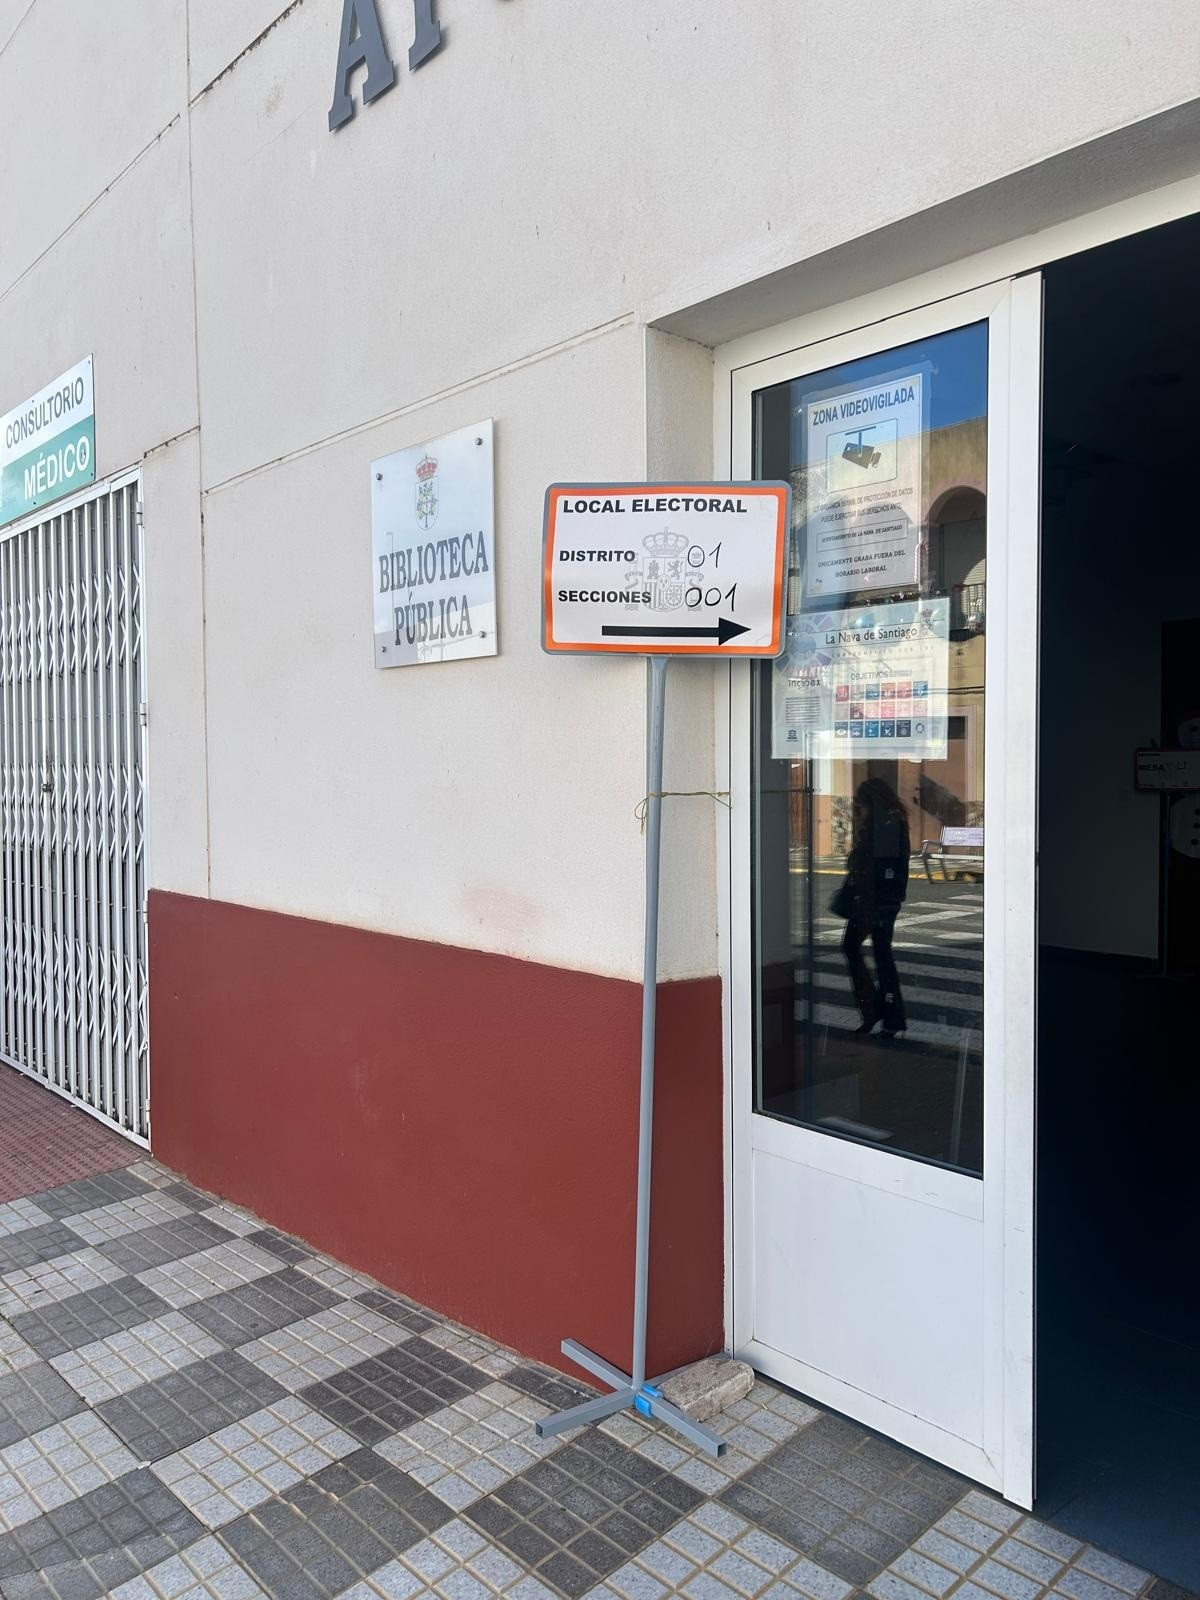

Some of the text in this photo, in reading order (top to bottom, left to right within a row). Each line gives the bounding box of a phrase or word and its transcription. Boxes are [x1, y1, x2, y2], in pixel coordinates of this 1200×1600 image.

[5, 376, 84, 449] CONSULTORIO
[813, 386, 915, 426] ZONA VIDEOVIGILADA
[24, 435, 90, 501] MÉDICO
[562, 498, 748, 513] LOCAL ELECTORAL
[899, 487, 913, 496] DATOS
[378, 530, 489, 594] BIBLIOTECA
[559, 541, 722, 569] DISTRITO 01
[873, 551, 893, 560] FUERA
[893, 549, 907, 557] DEL
[834, 565, 887, 578] HORARIO LABORAL
[558, 582, 738, 612] SECCIONES 001
[394, 591, 473, 646] PÚBLICA
[825, 626, 917, 645] La Nava de Santiago
[850, 670, 889, 681] OBJETIVOS
